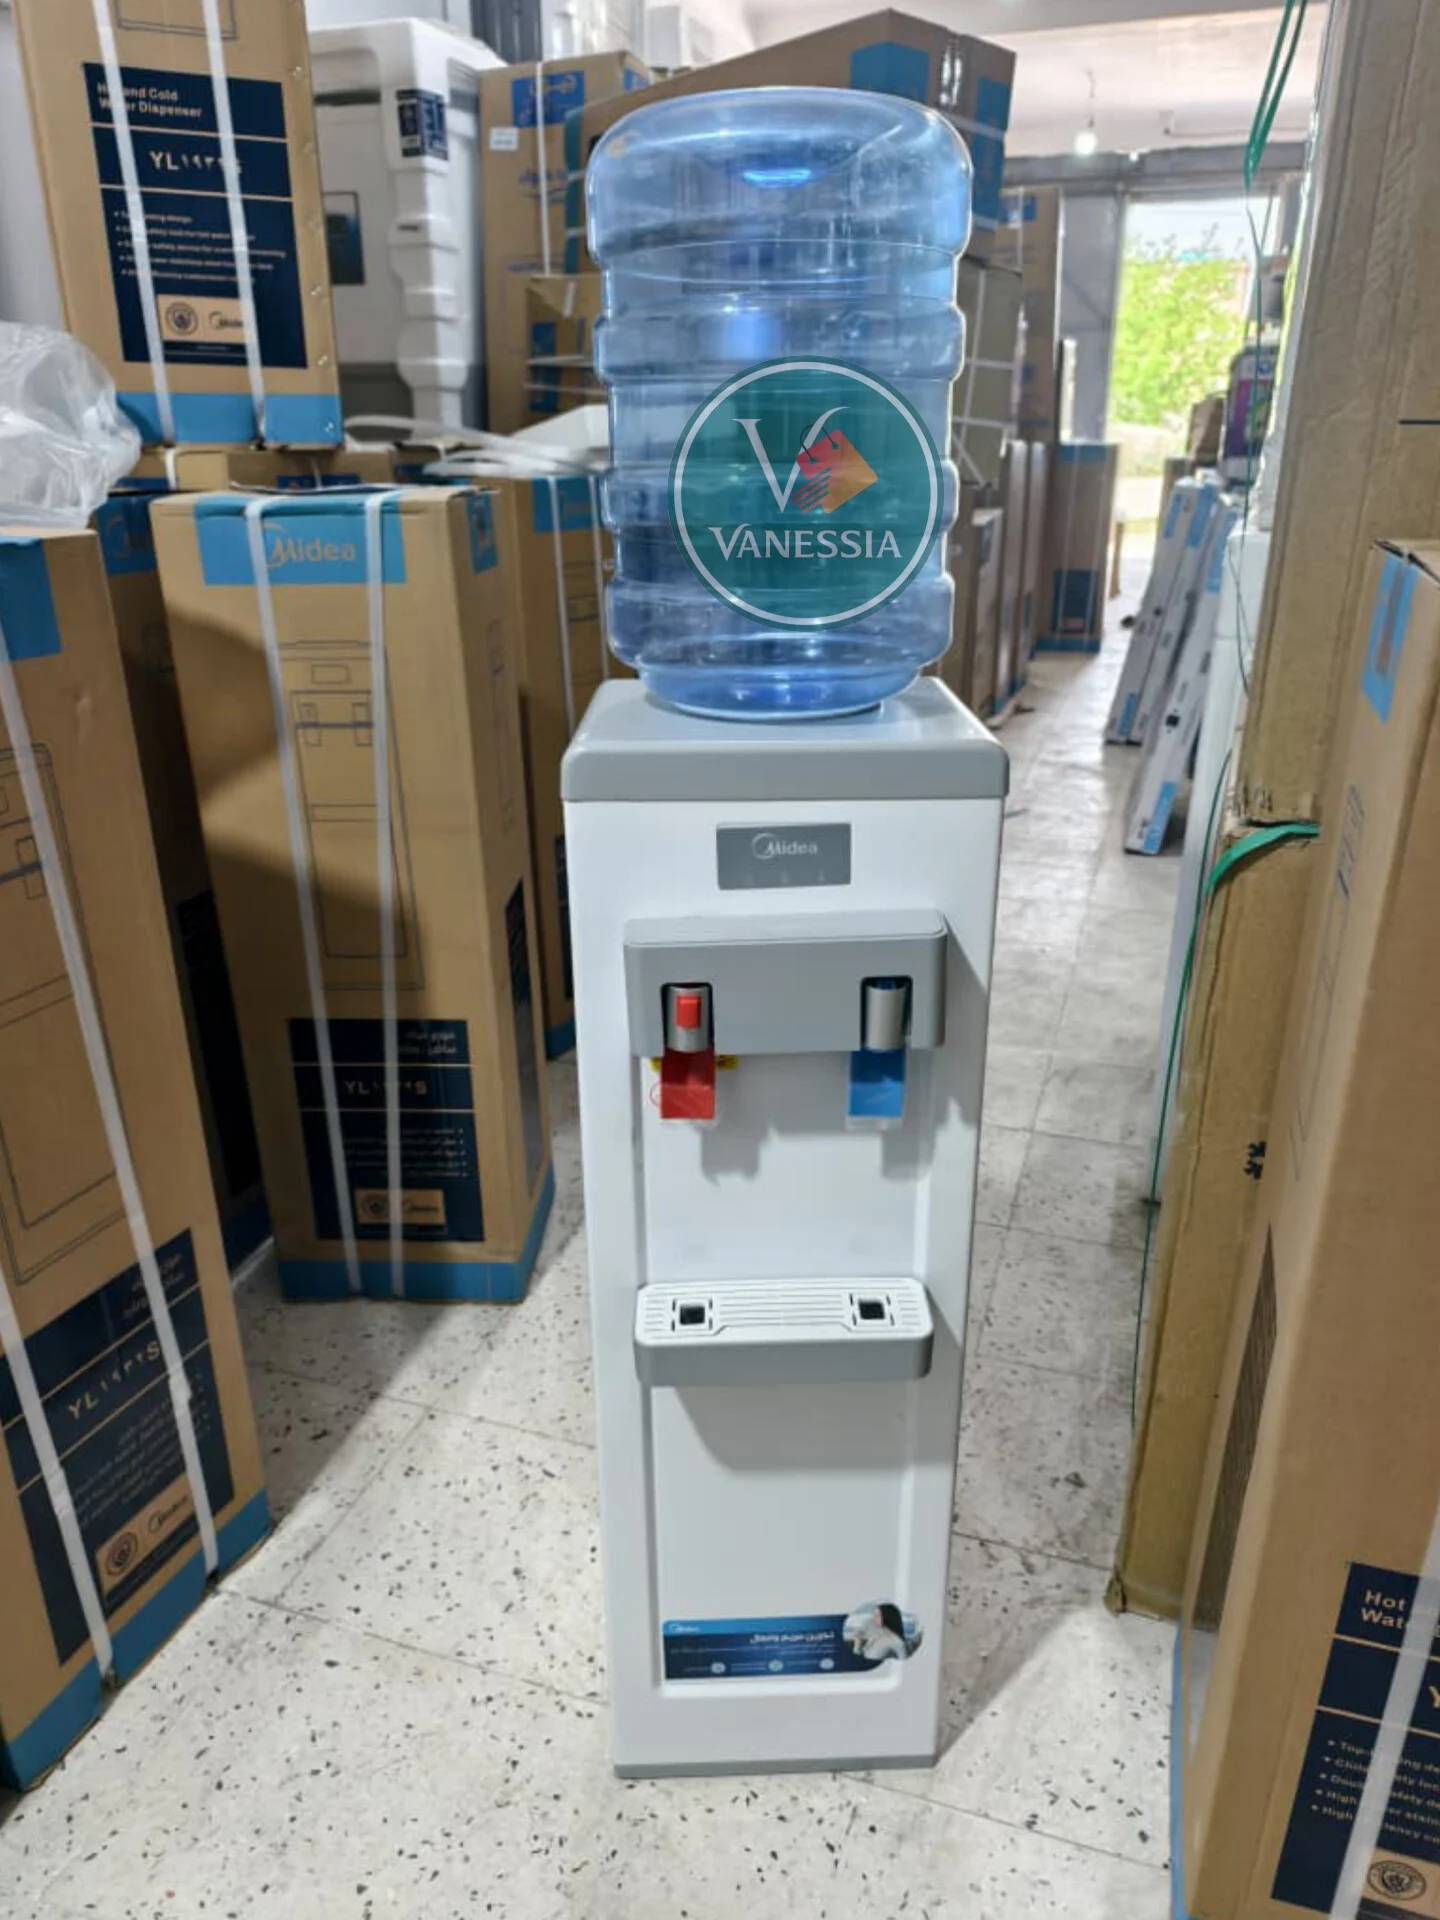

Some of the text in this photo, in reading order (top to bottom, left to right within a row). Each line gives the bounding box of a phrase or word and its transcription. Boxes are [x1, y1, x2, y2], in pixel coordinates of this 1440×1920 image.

[148, 88, 178, 100] Cold
[138, 101, 202, 117] Dispenser
[267, 532, 356, 566] Midea
[757, 836, 818, 857] Midea
[1364, 1589, 1408, 1611] Hot
[1360, 1607, 1408, 1629] Wat
